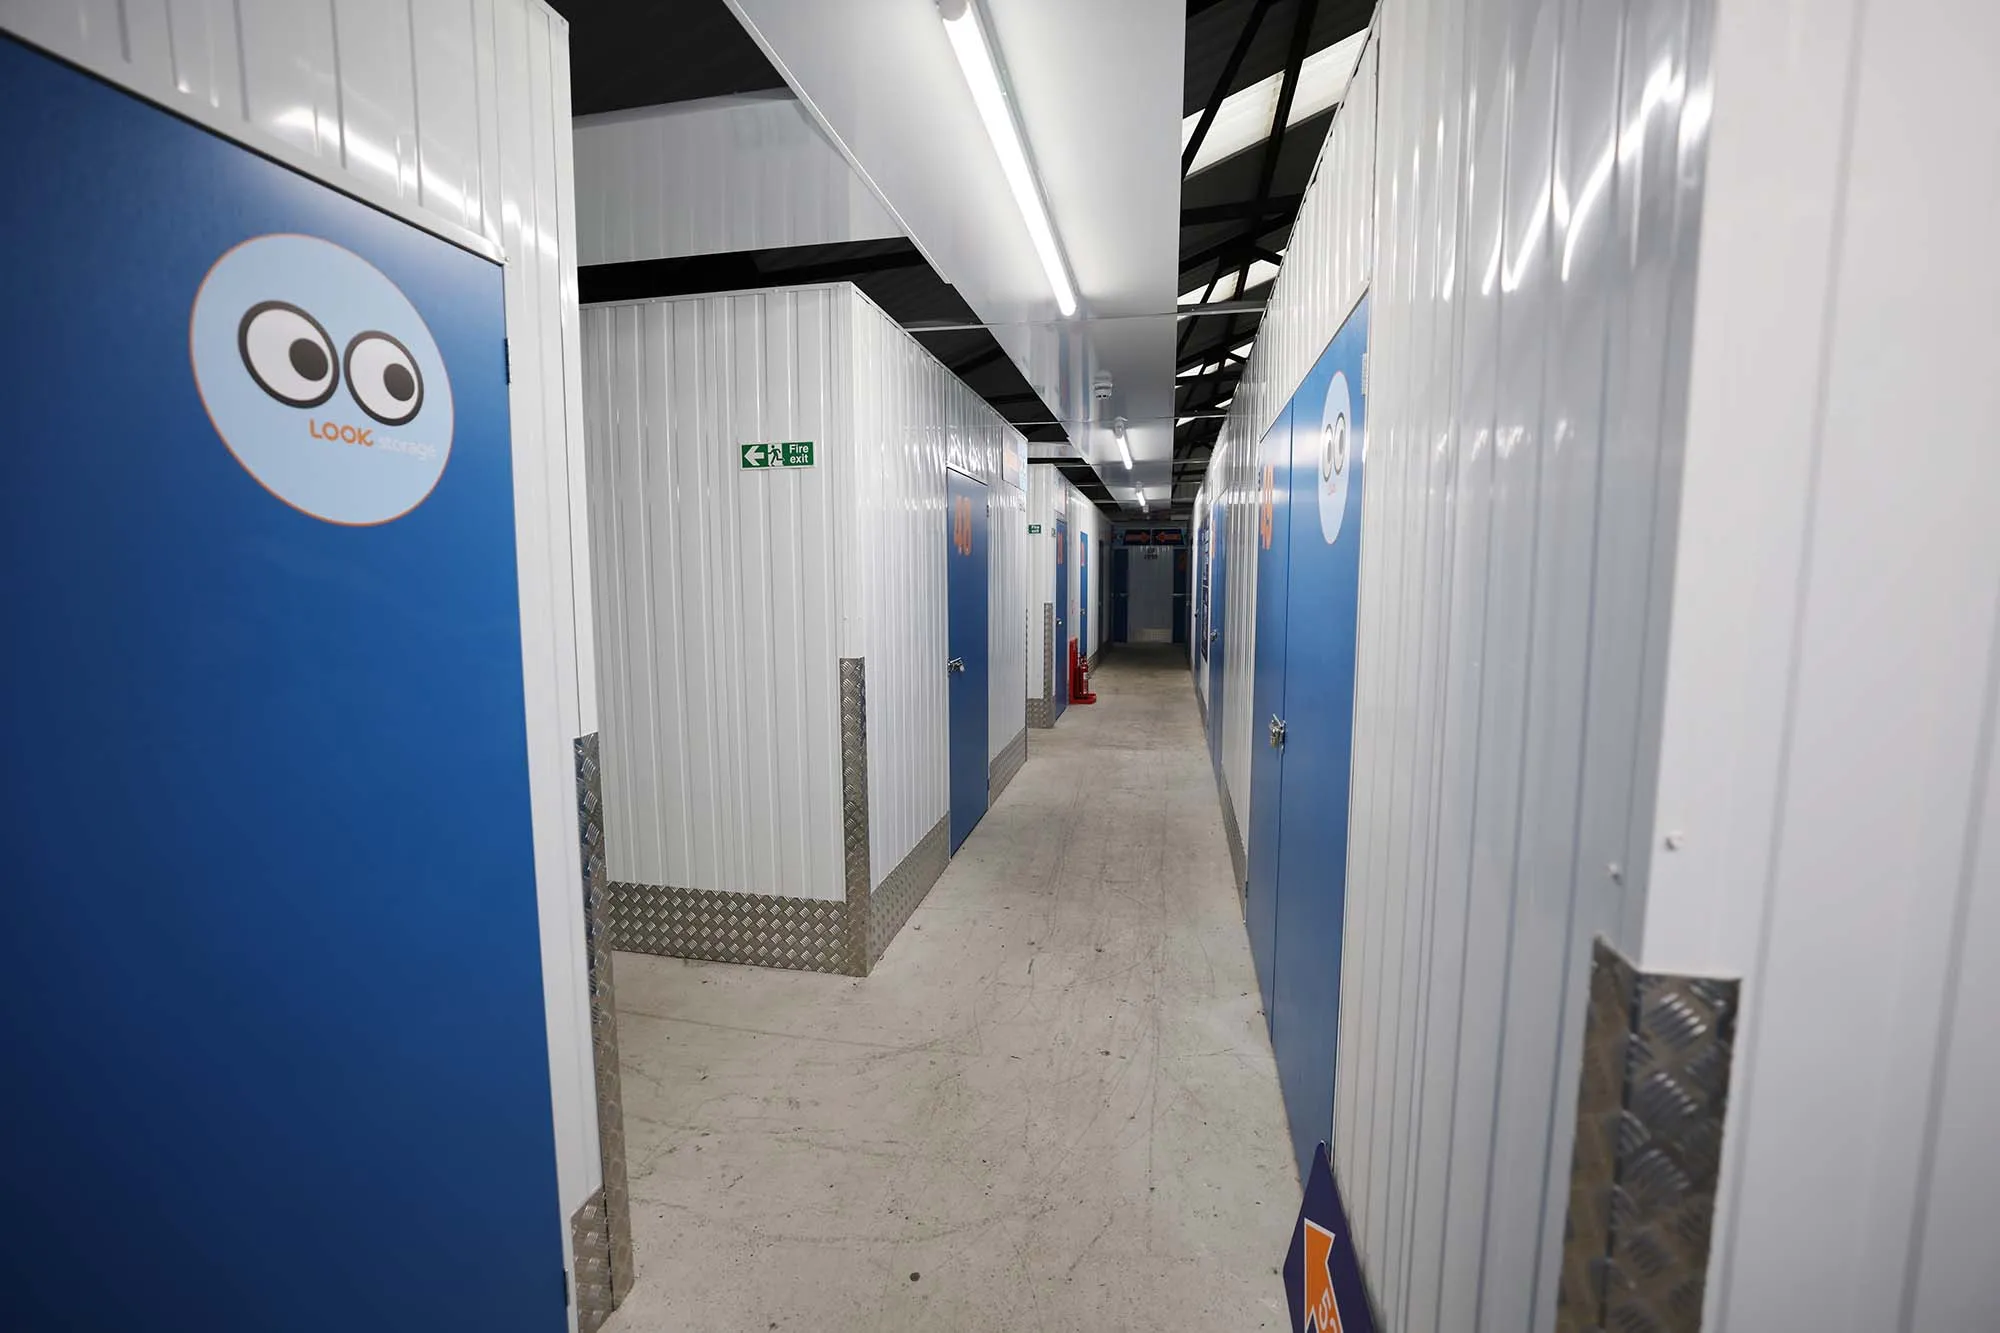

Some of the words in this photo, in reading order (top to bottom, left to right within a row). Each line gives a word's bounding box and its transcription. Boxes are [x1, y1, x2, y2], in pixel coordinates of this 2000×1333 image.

[309, 418, 374, 446] LOOK
[788, 443, 809, 454] Fire
[789, 454, 809, 464] exit
